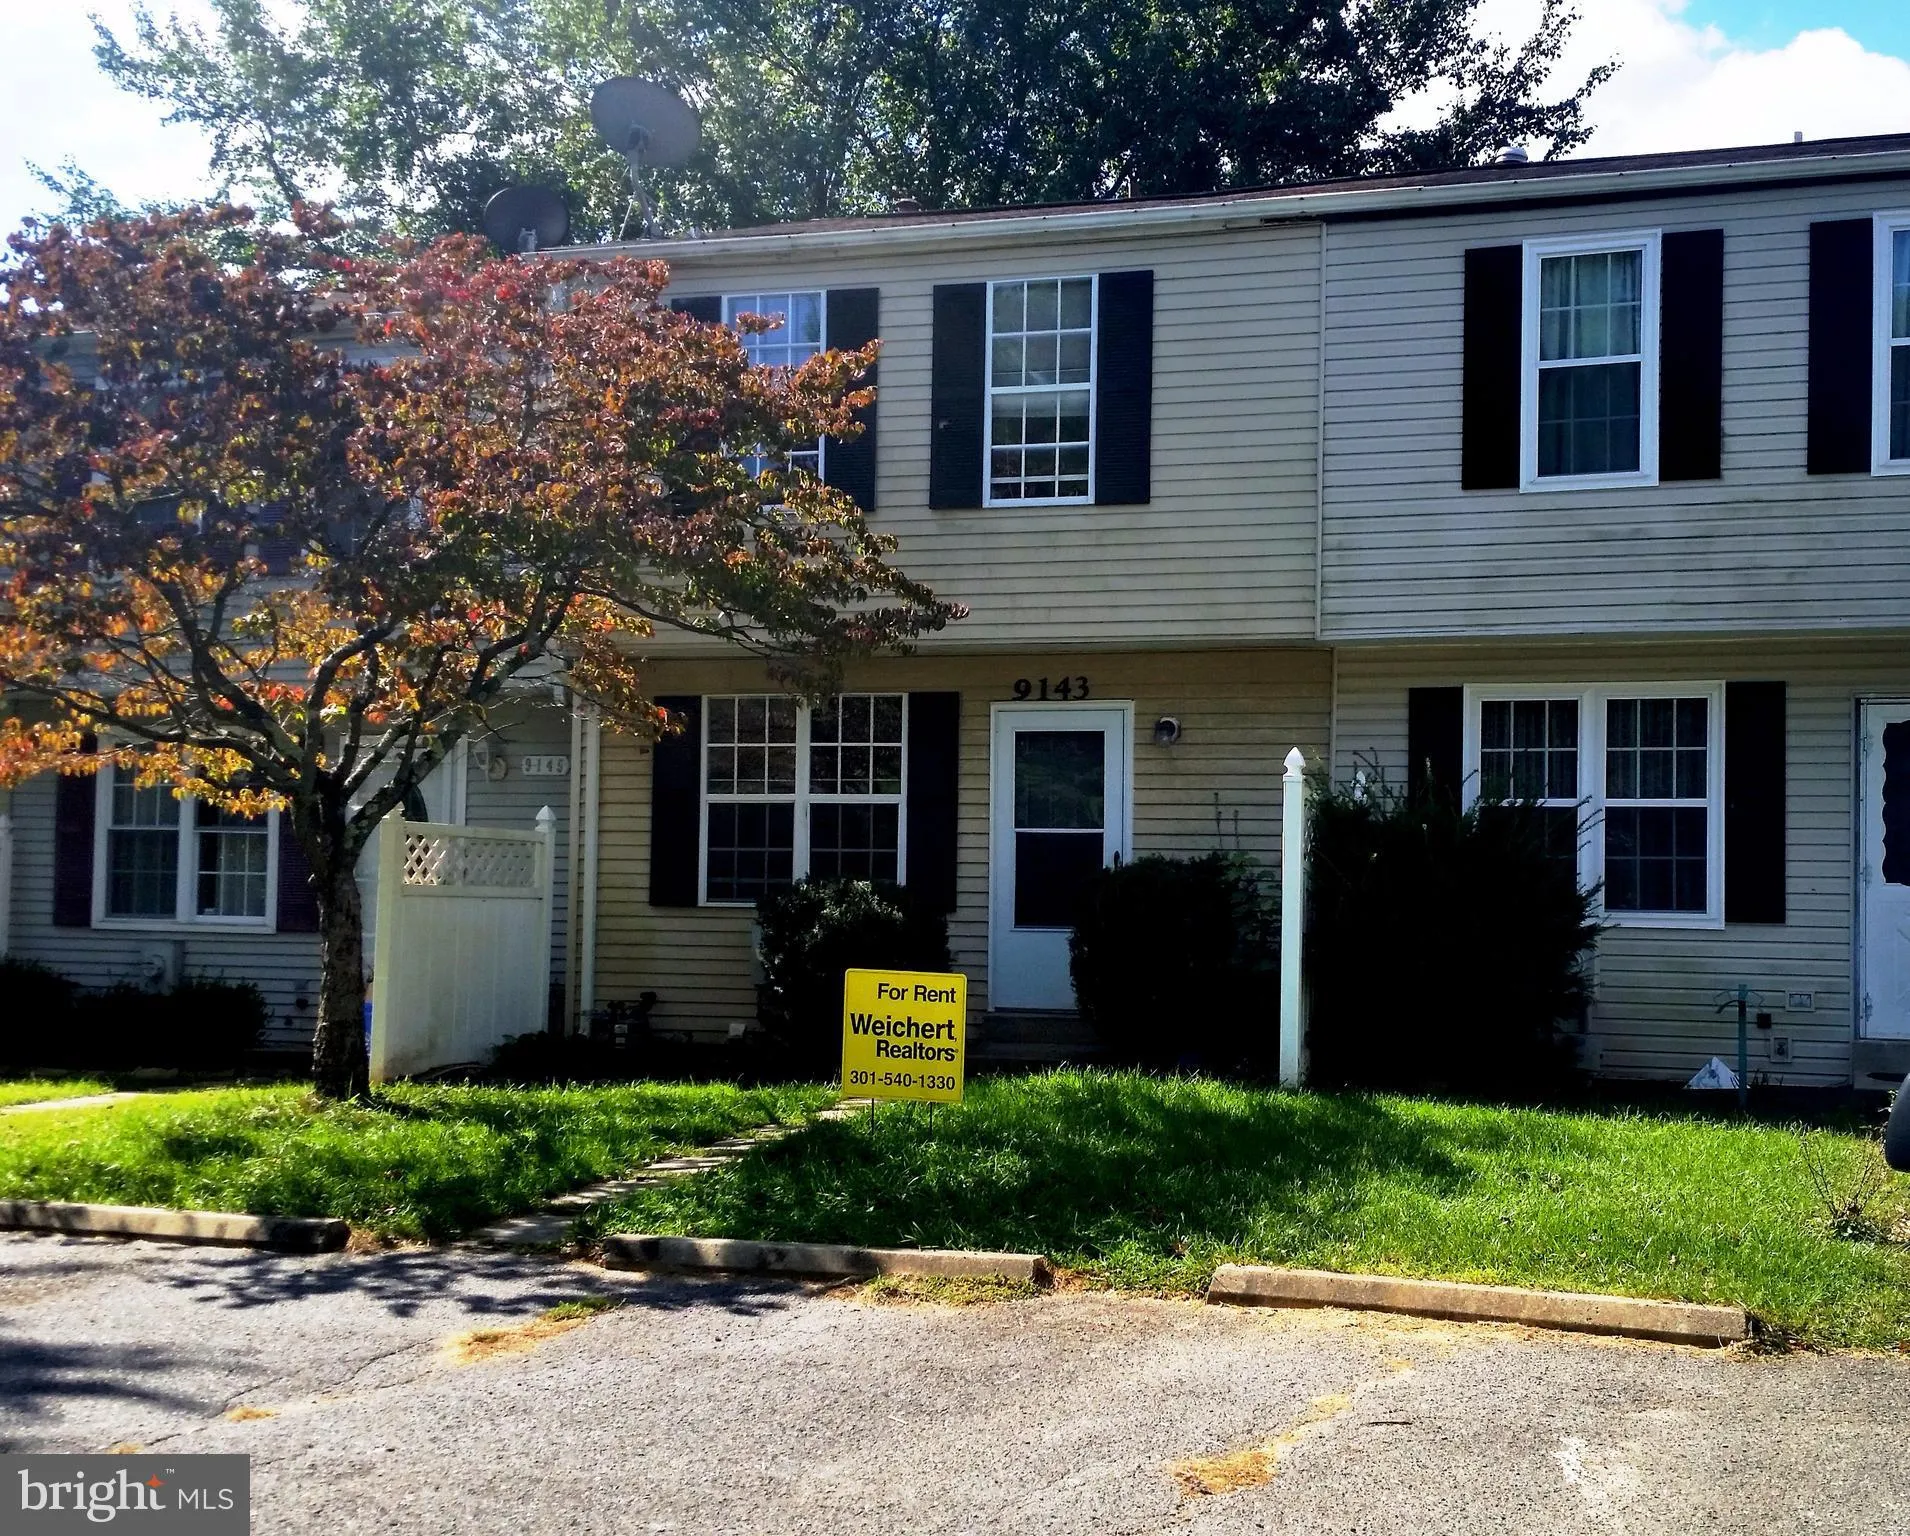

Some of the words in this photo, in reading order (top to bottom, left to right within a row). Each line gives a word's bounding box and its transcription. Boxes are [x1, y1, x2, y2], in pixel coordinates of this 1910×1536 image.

[1011, 676, 1090, 701] 9143
[877, 982, 909, 1001] For
[913, 984, 957, 1003] Rent
[849, 1070, 956, 1091] 301-540-1330
